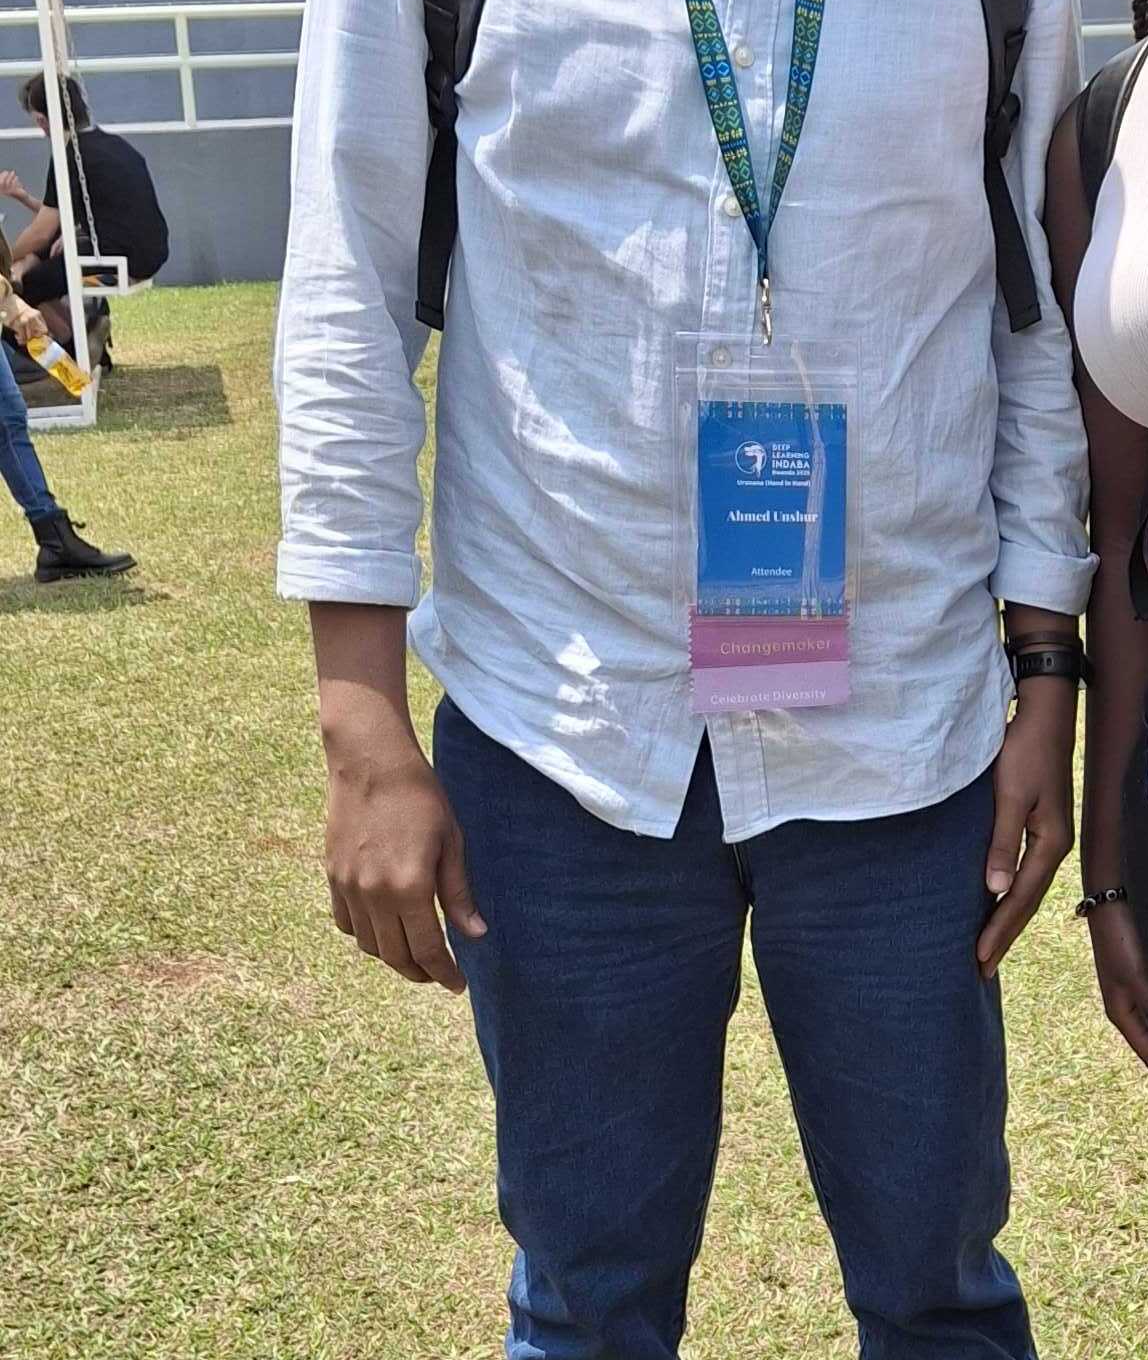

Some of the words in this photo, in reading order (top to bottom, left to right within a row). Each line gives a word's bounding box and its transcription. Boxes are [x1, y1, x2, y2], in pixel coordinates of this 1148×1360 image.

[771, 460, 810, 469] INDABA
[727, 510, 770, 522] Ahmed
[773, 510, 818, 522] Unshur
[751, 566, 793, 577] Attendee
[720, 638, 832, 656] Changemaker
[710, 691, 770, 705] Celebrate
[772, 689, 826, 702] Diversity
